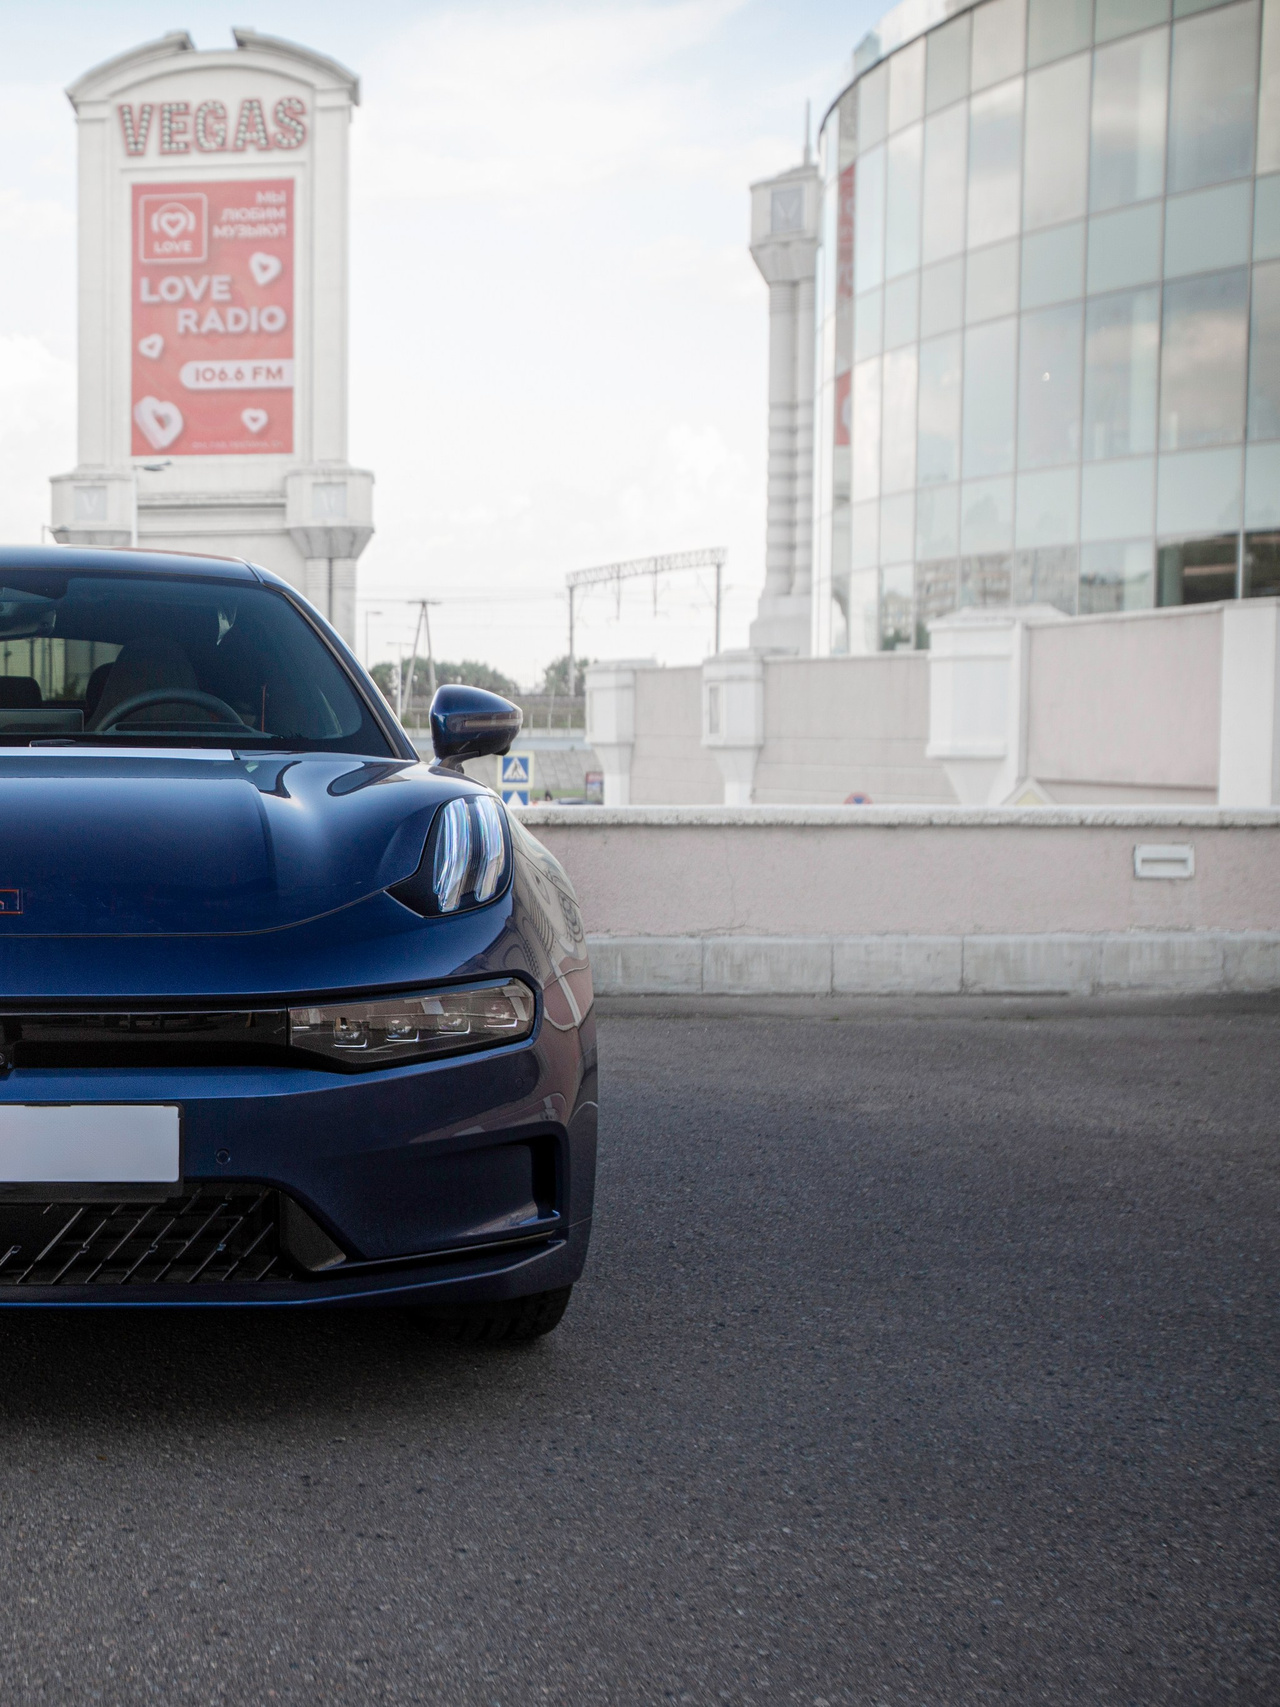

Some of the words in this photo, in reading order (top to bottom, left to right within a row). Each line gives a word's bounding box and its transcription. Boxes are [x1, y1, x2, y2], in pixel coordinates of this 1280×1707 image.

[118, 97, 307, 156] VEGAS
[256, 191, 286, 204] МЫ
[222, 207, 286, 222] ЛЮБИМ
[153, 240, 193, 254] LOVE
[140, 275, 232, 303] LOVE
[177, 306, 287, 334] RADIO
[195, 368, 245, 382] 106.6
[252, 366, 284, 381] FM
